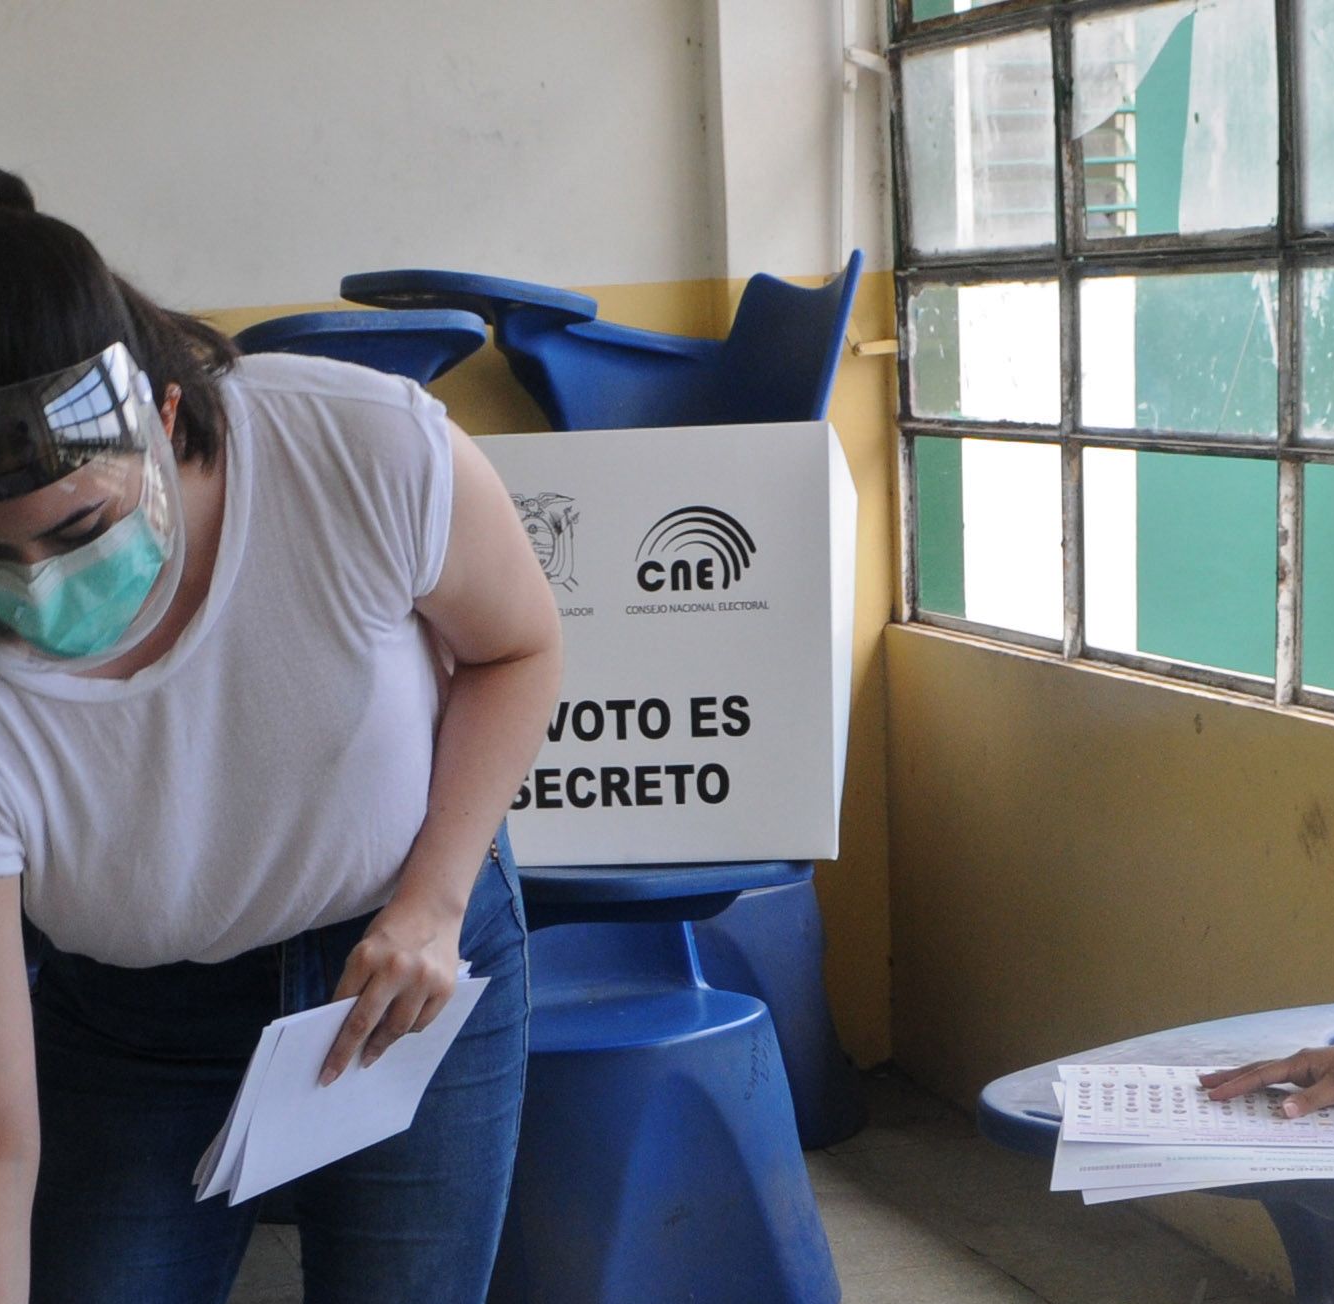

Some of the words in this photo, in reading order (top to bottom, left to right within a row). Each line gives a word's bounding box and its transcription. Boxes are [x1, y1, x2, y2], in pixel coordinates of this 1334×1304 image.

[558, 607, 595, 617] UADOR
[625, 604, 667, 616] CONSEJO
[668, 603, 716, 614] NACIONAL
[718, 601, 769, 612] ELECTORAL
[690, 695, 750, 738] ES
